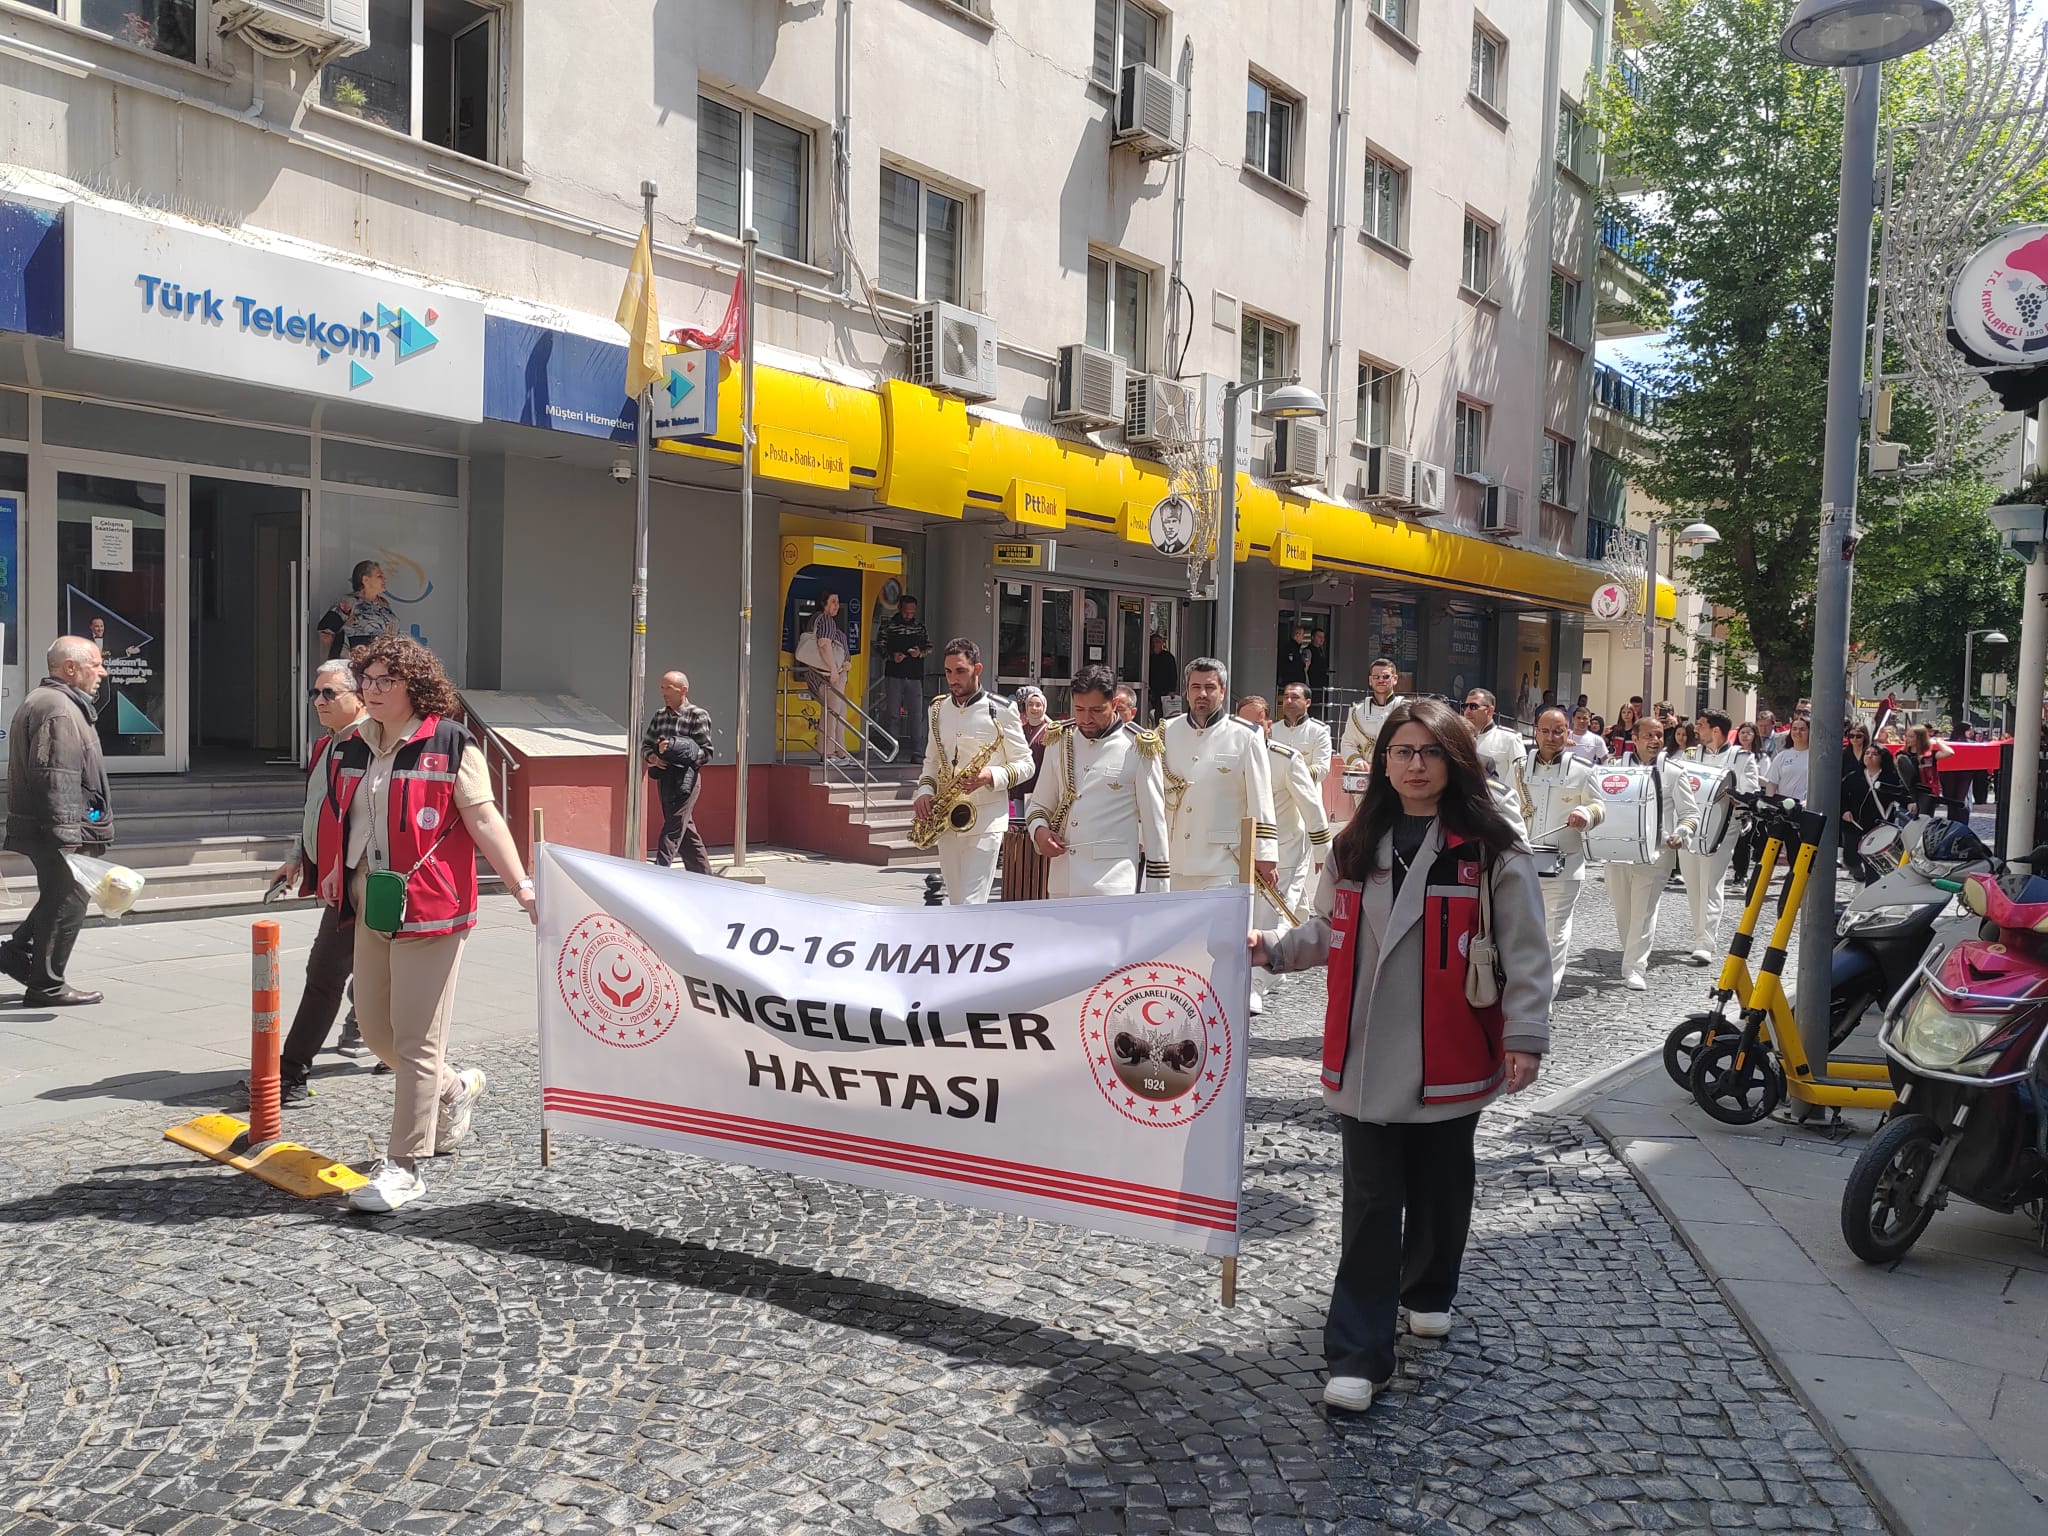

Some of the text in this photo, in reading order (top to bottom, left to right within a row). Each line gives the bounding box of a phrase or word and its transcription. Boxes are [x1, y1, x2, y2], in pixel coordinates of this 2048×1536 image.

[136, 273, 380, 354] Türk Telekom
[545, 404, 634, 431] Müşteri Hizmetleri
[769, 443, 844, 474] Posta Banka Lojistik
[103, 658, 148, 667] elekom'la
[726, 922, 1014, 974] 10-16 MAYIS
[1123, 989, 1168, 1006] KIRKLARELİ
[683, 976, 1056, 1051] ENGELLİLER
[744, 1049, 1000, 1124] HAFTASI
[1143, 1078, 1166, 1092] 1924
